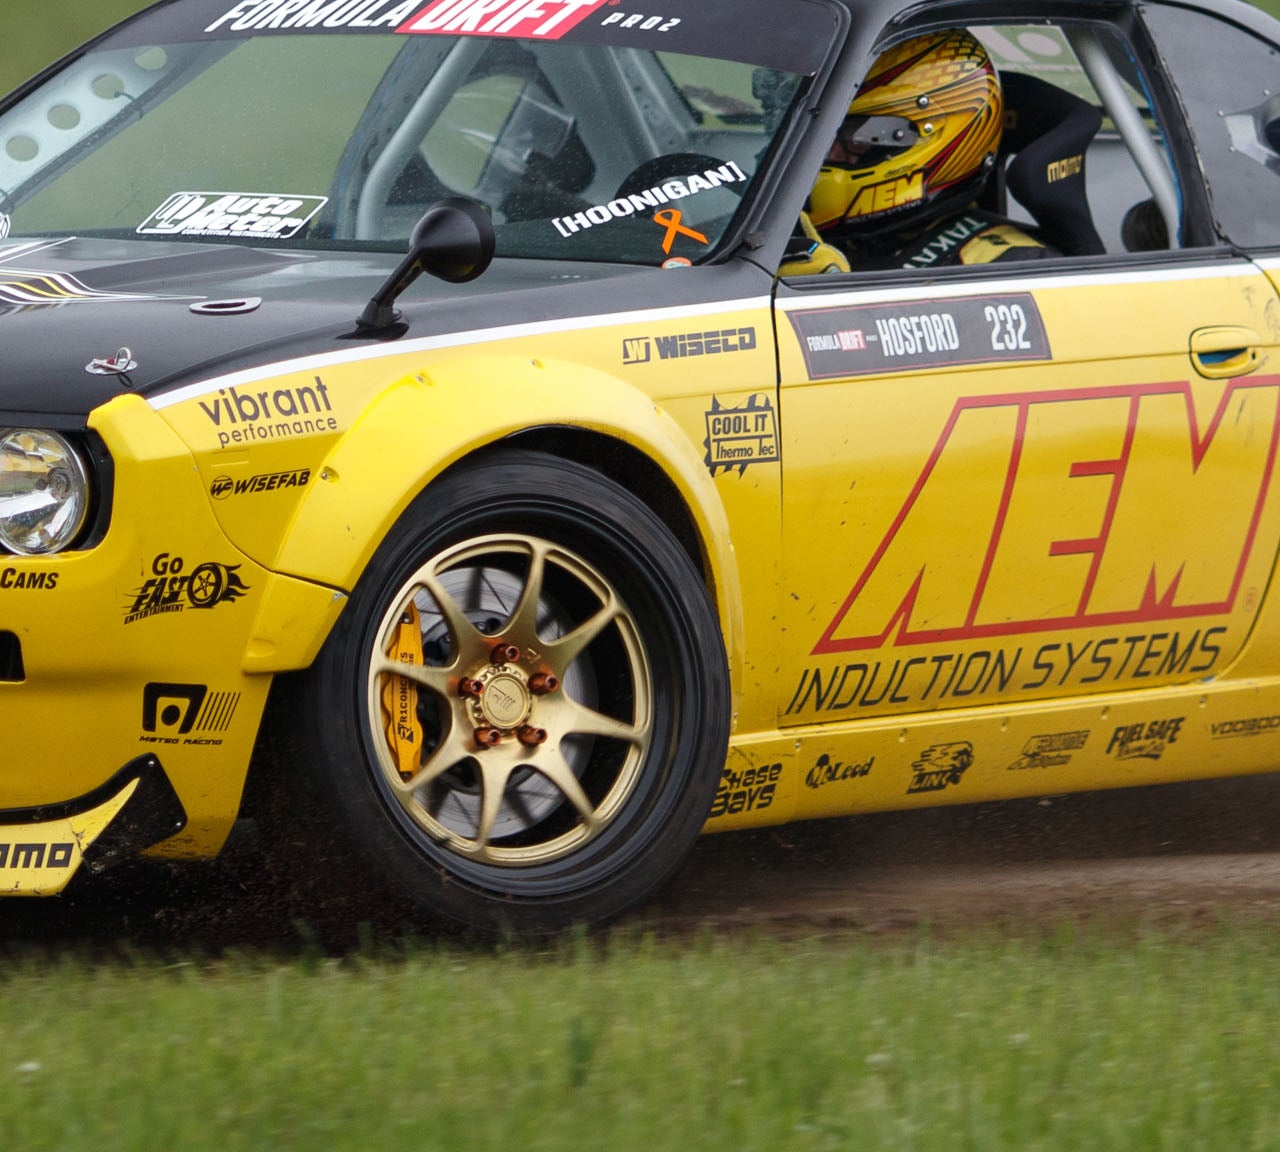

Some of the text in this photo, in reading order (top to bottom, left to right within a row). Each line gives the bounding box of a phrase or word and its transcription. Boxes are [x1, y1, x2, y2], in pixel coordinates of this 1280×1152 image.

[601, 12, 681, 32] PRO2
[199, 195, 304, 215] Auto
[551, 160, 748, 238] [HOONIGAN]
[177, 211, 304, 233] Meter
[876, 304, 1031, 357] HOSFORD 232
[198, 376, 333, 426] vibrant
[217, 417, 338, 449] performance
[712, 414, 768, 436] COOL IT
[712, 435, 774, 460] Thermo Tec
[234, 469, 311, 495] WISEFAB
[151, 553, 184, 576] Go
[0, 567, 60, 590] CAMS
[128, 576, 190, 614] FAST
[123, 604, 185, 625] ENTERTAINMENT
[785, 626, 1228, 715] INDUCTION SYSTEMS
